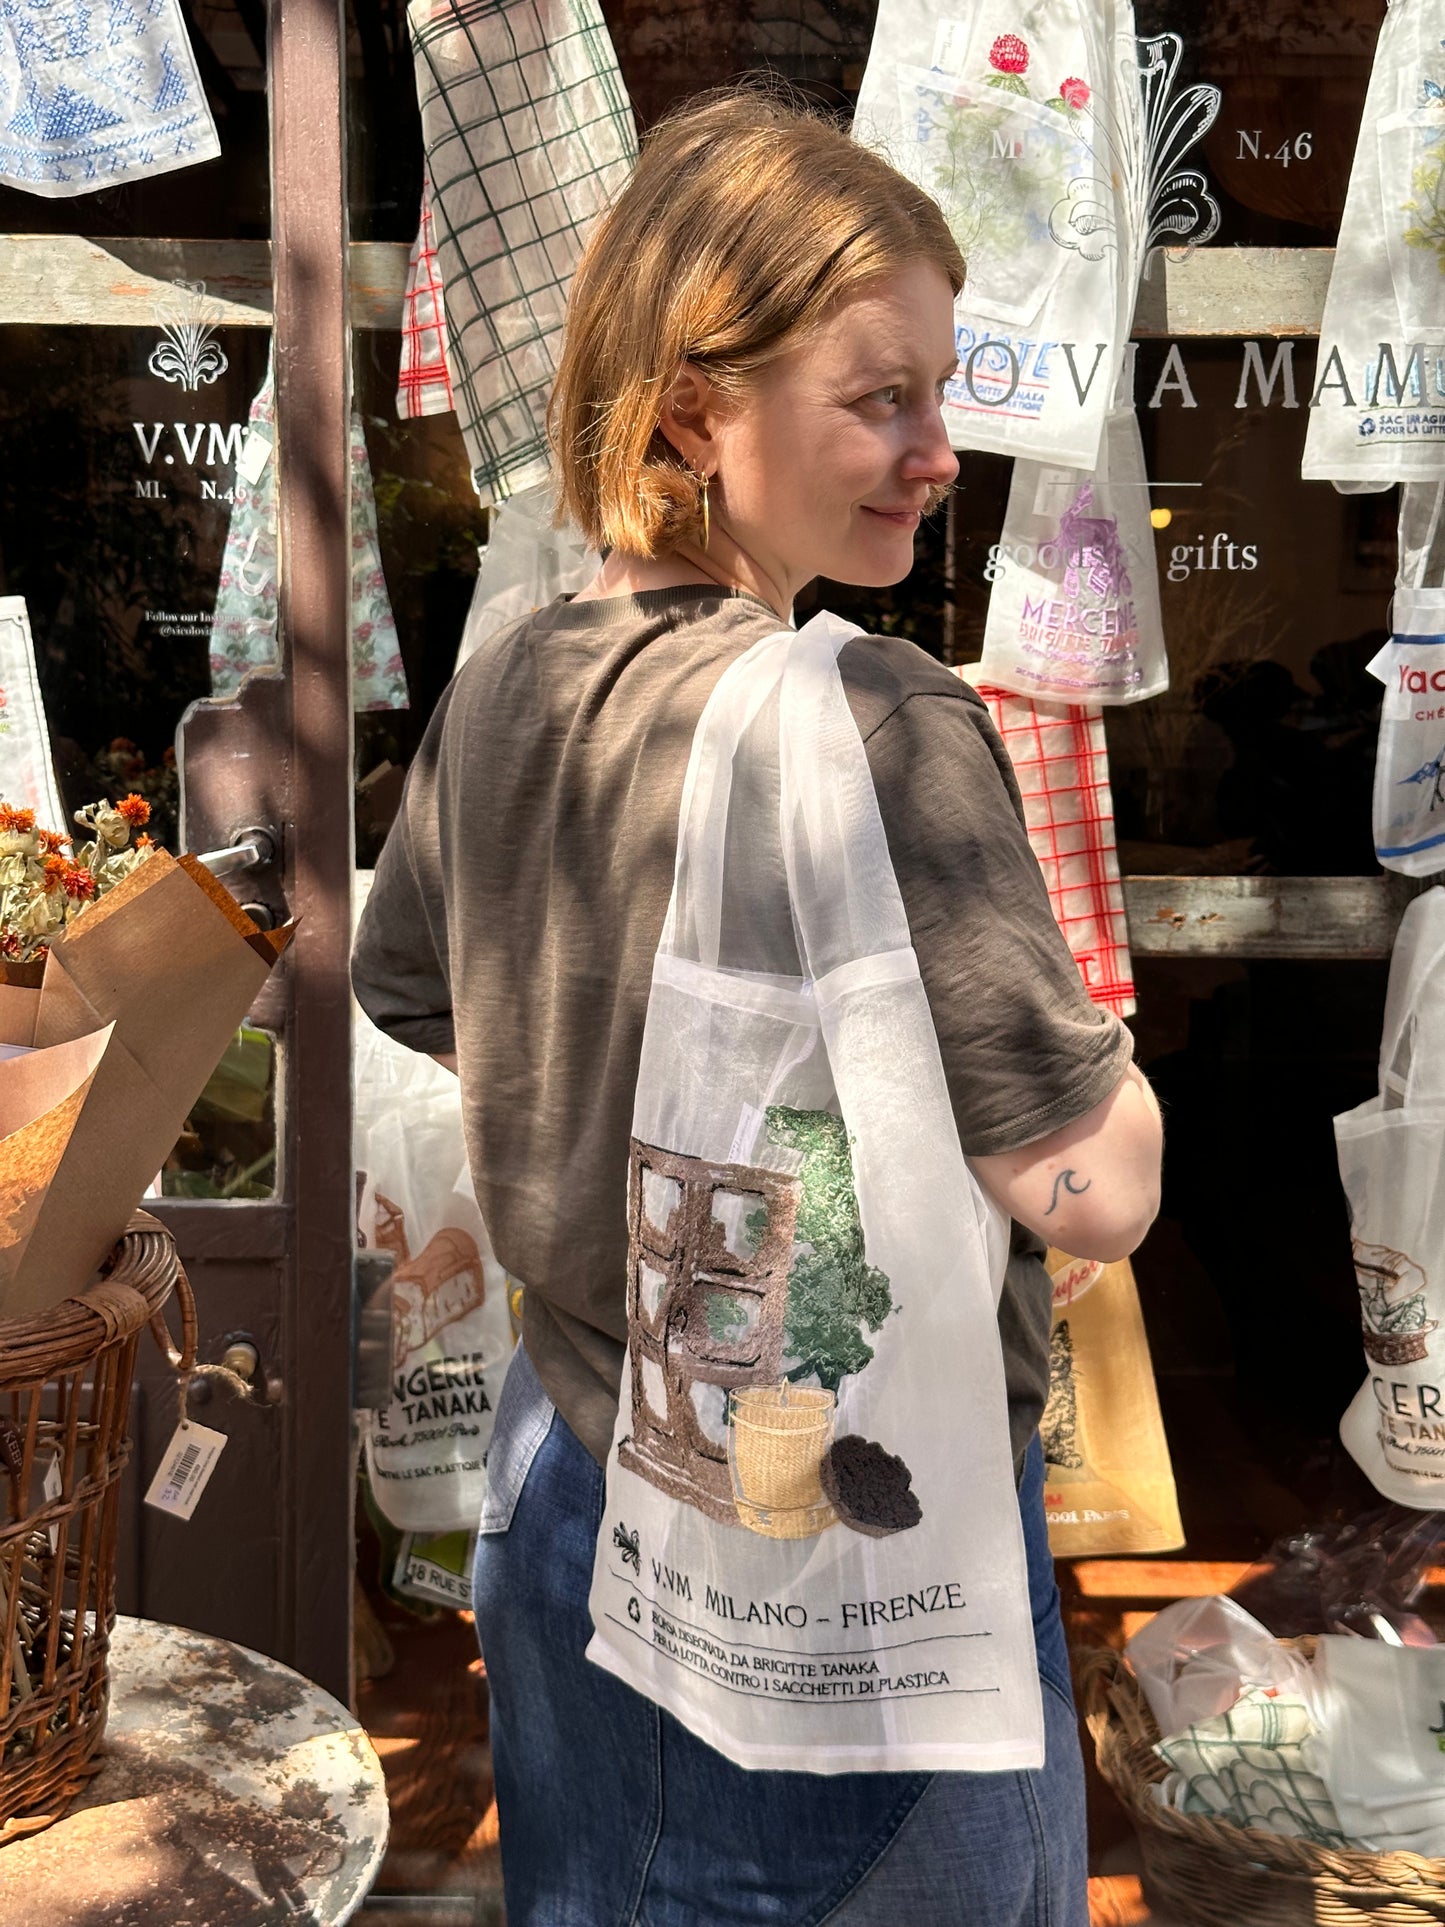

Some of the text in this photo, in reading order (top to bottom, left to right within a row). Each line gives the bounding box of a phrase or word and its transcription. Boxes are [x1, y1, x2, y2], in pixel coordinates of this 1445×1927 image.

[1236, 130, 1313, 168] N.46
[1060, 342, 1198, 408] VIA
[1379, 415, 1403, 425] SAC
[1379, 425, 1405, 435] POUR
[1406, 425, 1419, 434] LA
[135, 481, 247, 505] MI. N.46
[1167, 532, 1258, 582] gifts
[145, 610, 178, 622] Follow
[180, 613, 198, 622] our
[1052, 1260, 1097, 1306] uper
[402, 1390, 492, 1425] TANAKA
[429, 1568, 457, 1593] RUE
[651, 1557, 693, 1602] V.VM
[705, 1583, 808, 1629] MILANO
[841, 1582, 967, 1629] FIRENZE
[668, 1639, 680, 1657] LA
[680, 1645, 710, 1673] LOTTA
[711, 1662, 761, 1690] CONTRO
[772, 1678, 854, 1697] SACCHETTI
[858, 1681, 875, 1695] DI
[877, 1670, 950, 1693] PLASTICA
[730, 1653, 750, 1669] DA
[753, 1656, 817, 1678] BRIGITTE
[820, 1660, 880, 1677] TANAKA
